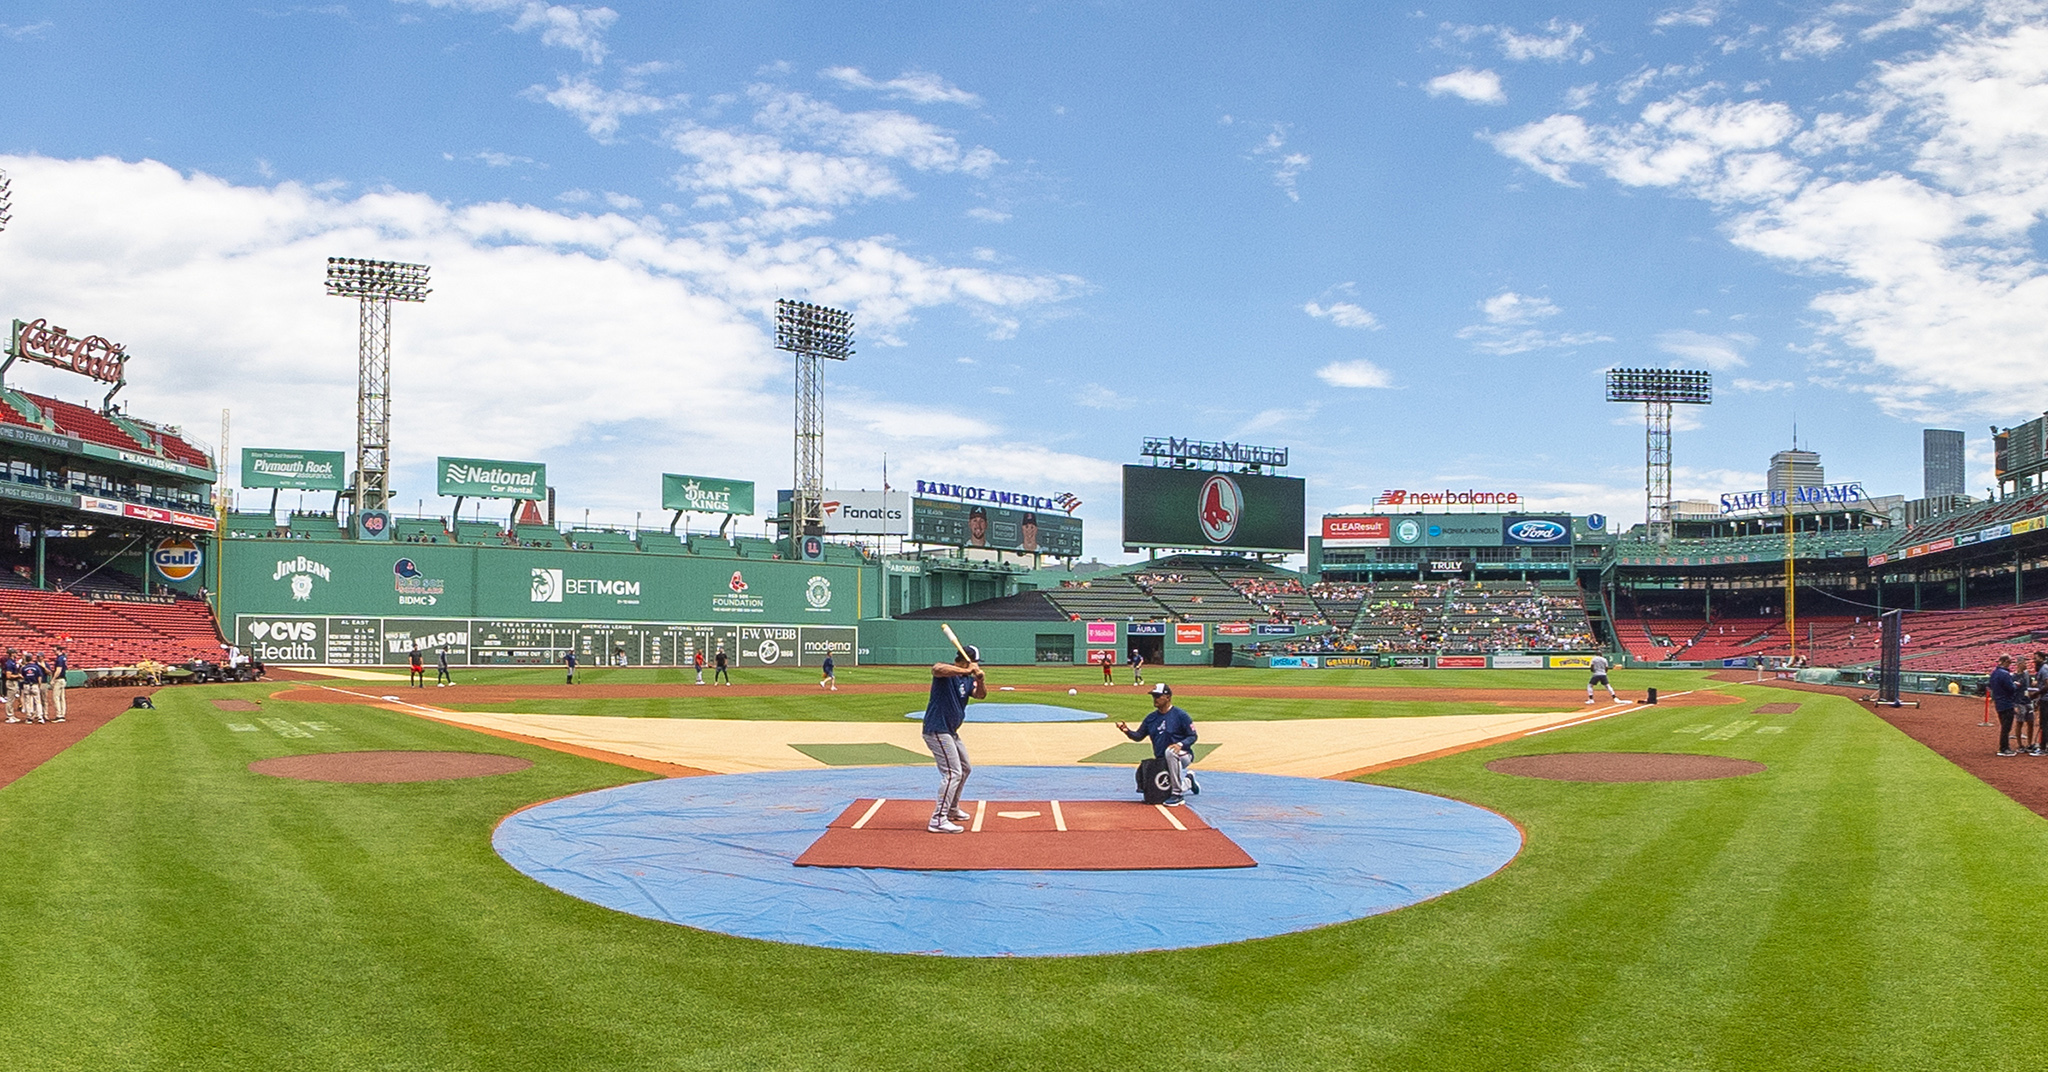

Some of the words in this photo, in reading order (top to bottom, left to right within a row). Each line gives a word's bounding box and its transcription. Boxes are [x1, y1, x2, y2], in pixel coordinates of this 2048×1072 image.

[1170, 436, 1288, 467] MassMutual
[254, 459, 303, 473] Plymouth
[305, 462, 333, 474] Rock
[467, 467, 534, 486] National
[491, 485, 506, 493] Car
[507, 486, 533, 494] Rental
[685, 488, 730, 501] DRAFT
[917, 480, 962, 498] BANK
[966, 487, 986, 500] OF
[990, 490, 1053, 510] AMERICA
[1410, 493, 1443, 504] new
[1446, 489, 1517, 504] balance
[1794, 484, 1861, 504] ADAMS
[691, 500, 729, 510] KINGS
[843, 506, 902, 519] Fanatcs
[1330, 522, 1382, 531] CLEAResult
[1519, 523, 1555, 538] Ford
[156, 550, 198, 565] Gulf
[273, 560, 296, 581] JIM
[297, 556, 332, 582] BEAM
[890, 564, 921, 573] ABIOMED
[1431, 562, 1462, 570] TRULY
[566, 579, 640, 596] BETMGM
[399, 596, 427, 605] BIDMC
[712, 598, 764, 607] FOUNDATION
[270, 621, 317, 641] CVS
[763, 628, 797, 640] WEBB
[415, 632, 468, 651] MASON
[804, 640, 851, 651] moderna
[250, 641, 317, 660] Health
